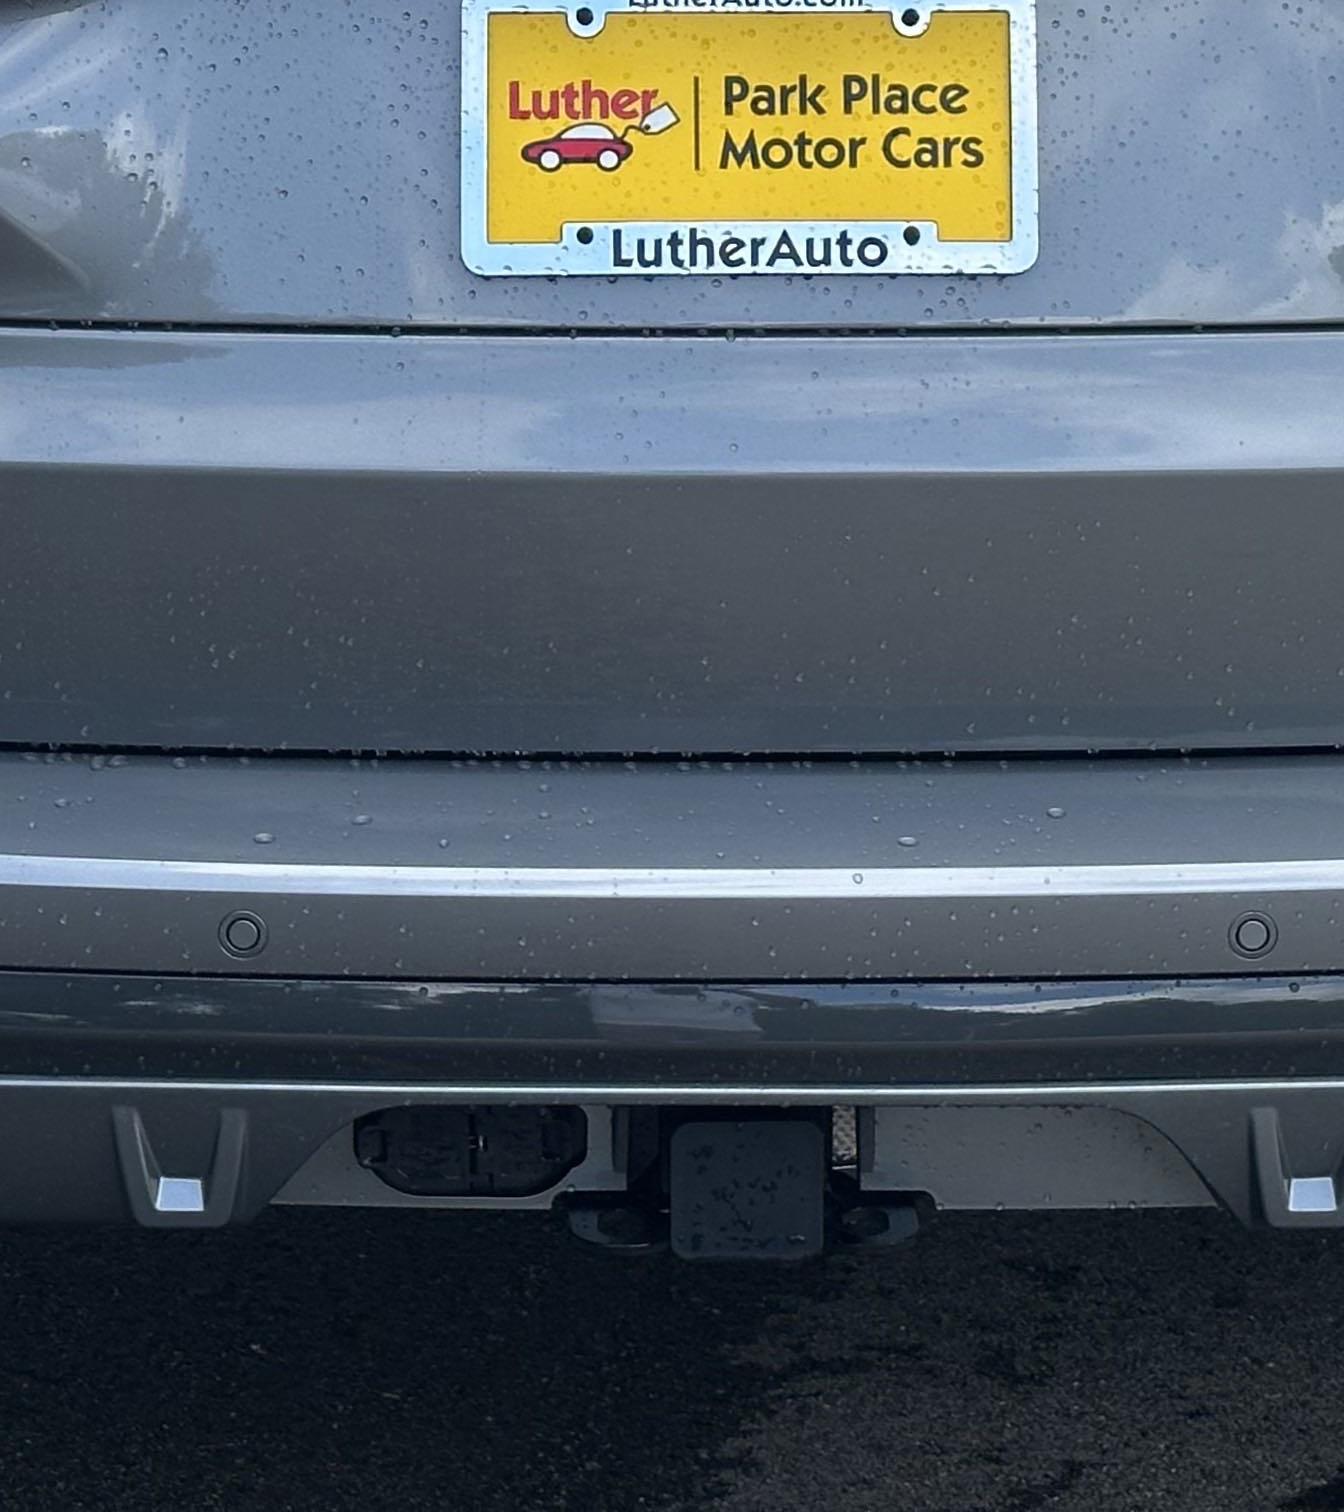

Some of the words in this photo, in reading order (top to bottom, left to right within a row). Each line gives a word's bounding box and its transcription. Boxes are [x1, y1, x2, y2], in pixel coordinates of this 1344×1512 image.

[509, 80, 659, 120] Luther
[723, 74, 827, 116] Park
[843, 75, 970, 115] Place
[719, 130, 867, 170] Motor
[882, 128, 985, 168] Cars
[612, 229, 889, 268] LutherAuto
